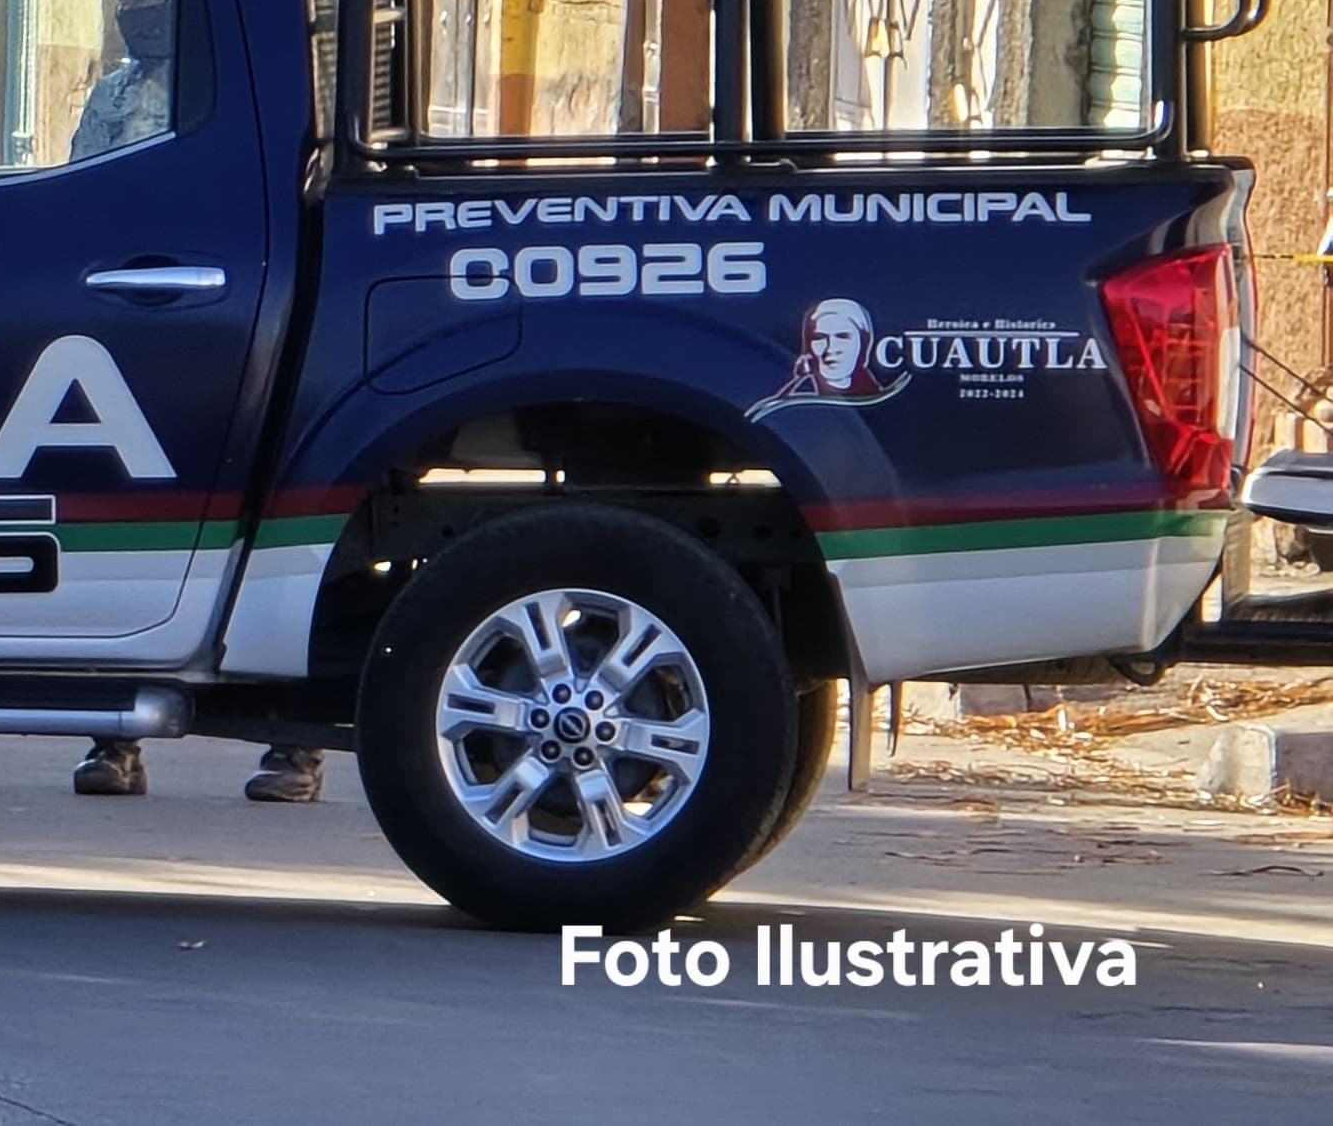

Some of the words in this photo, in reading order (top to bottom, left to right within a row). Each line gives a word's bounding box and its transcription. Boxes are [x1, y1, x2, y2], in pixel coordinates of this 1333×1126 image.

[373, 195, 751, 235] PREVENTIVA
[769, 192, 1091, 222] MUNICIPAL
[876, 336, 1108, 369] CUAUTLA
[960, 374, 1024, 383] MORELOS
[959, 388, 1025, 399] 2022-2024
